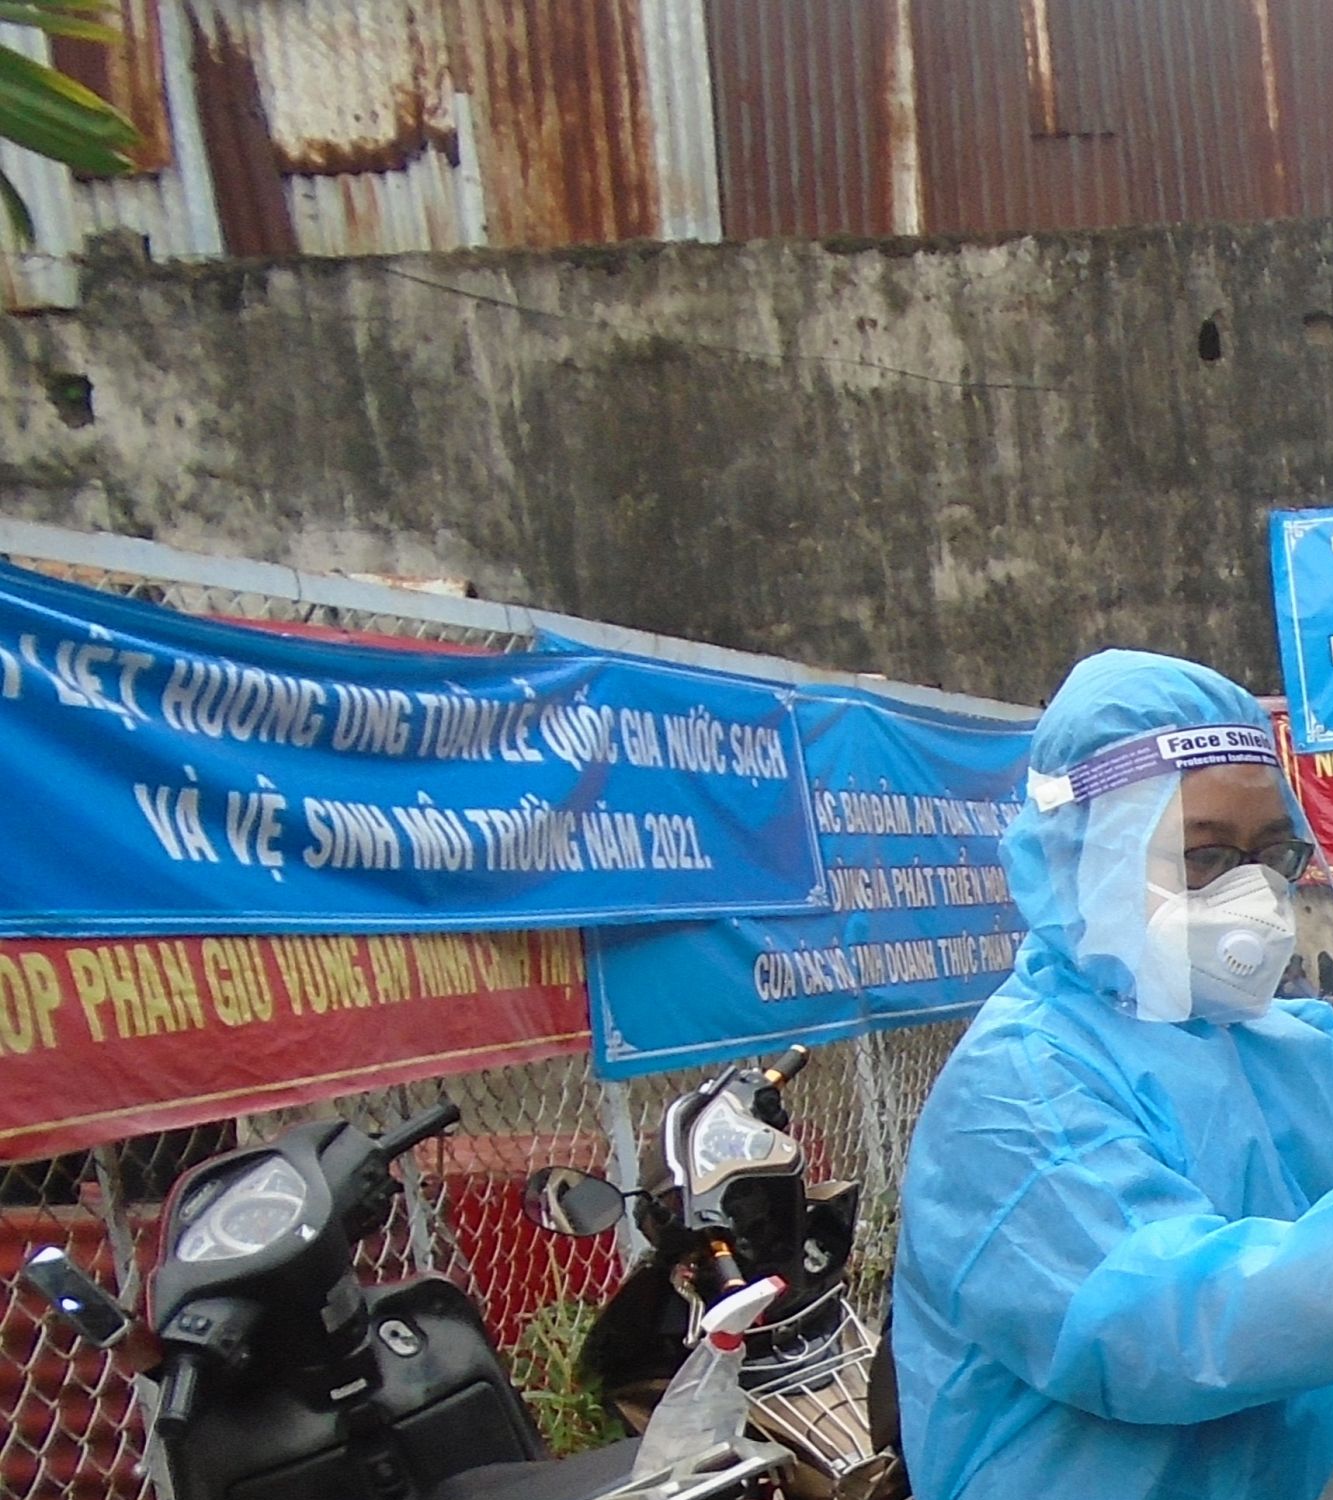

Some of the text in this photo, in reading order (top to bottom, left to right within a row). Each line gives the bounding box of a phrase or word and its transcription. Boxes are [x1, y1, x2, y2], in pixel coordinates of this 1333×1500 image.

[540, 683, 619, 772] QUỐC
[619, 706, 665, 768] GIA
[664, 704, 727, 775] NƯỚC
[729, 722, 789, 787] SẠCH
[1167, 735, 1221, 753] Face
[134, 765, 220, 863] VÀ
[227, 773, 286, 883] VỆ
[302, 796, 401, 870] SINH
[392, 790, 474, 871] MÔI
[464, 792, 584, 872] TRƯỜNG
[582, 799, 646, 870] NĂM
[914, 796, 938, 835] AN
[892, 856, 936, 908] PHÁT
[366, 934, 413, 1005] AN
[411, 933, 478, 1000] NINH
